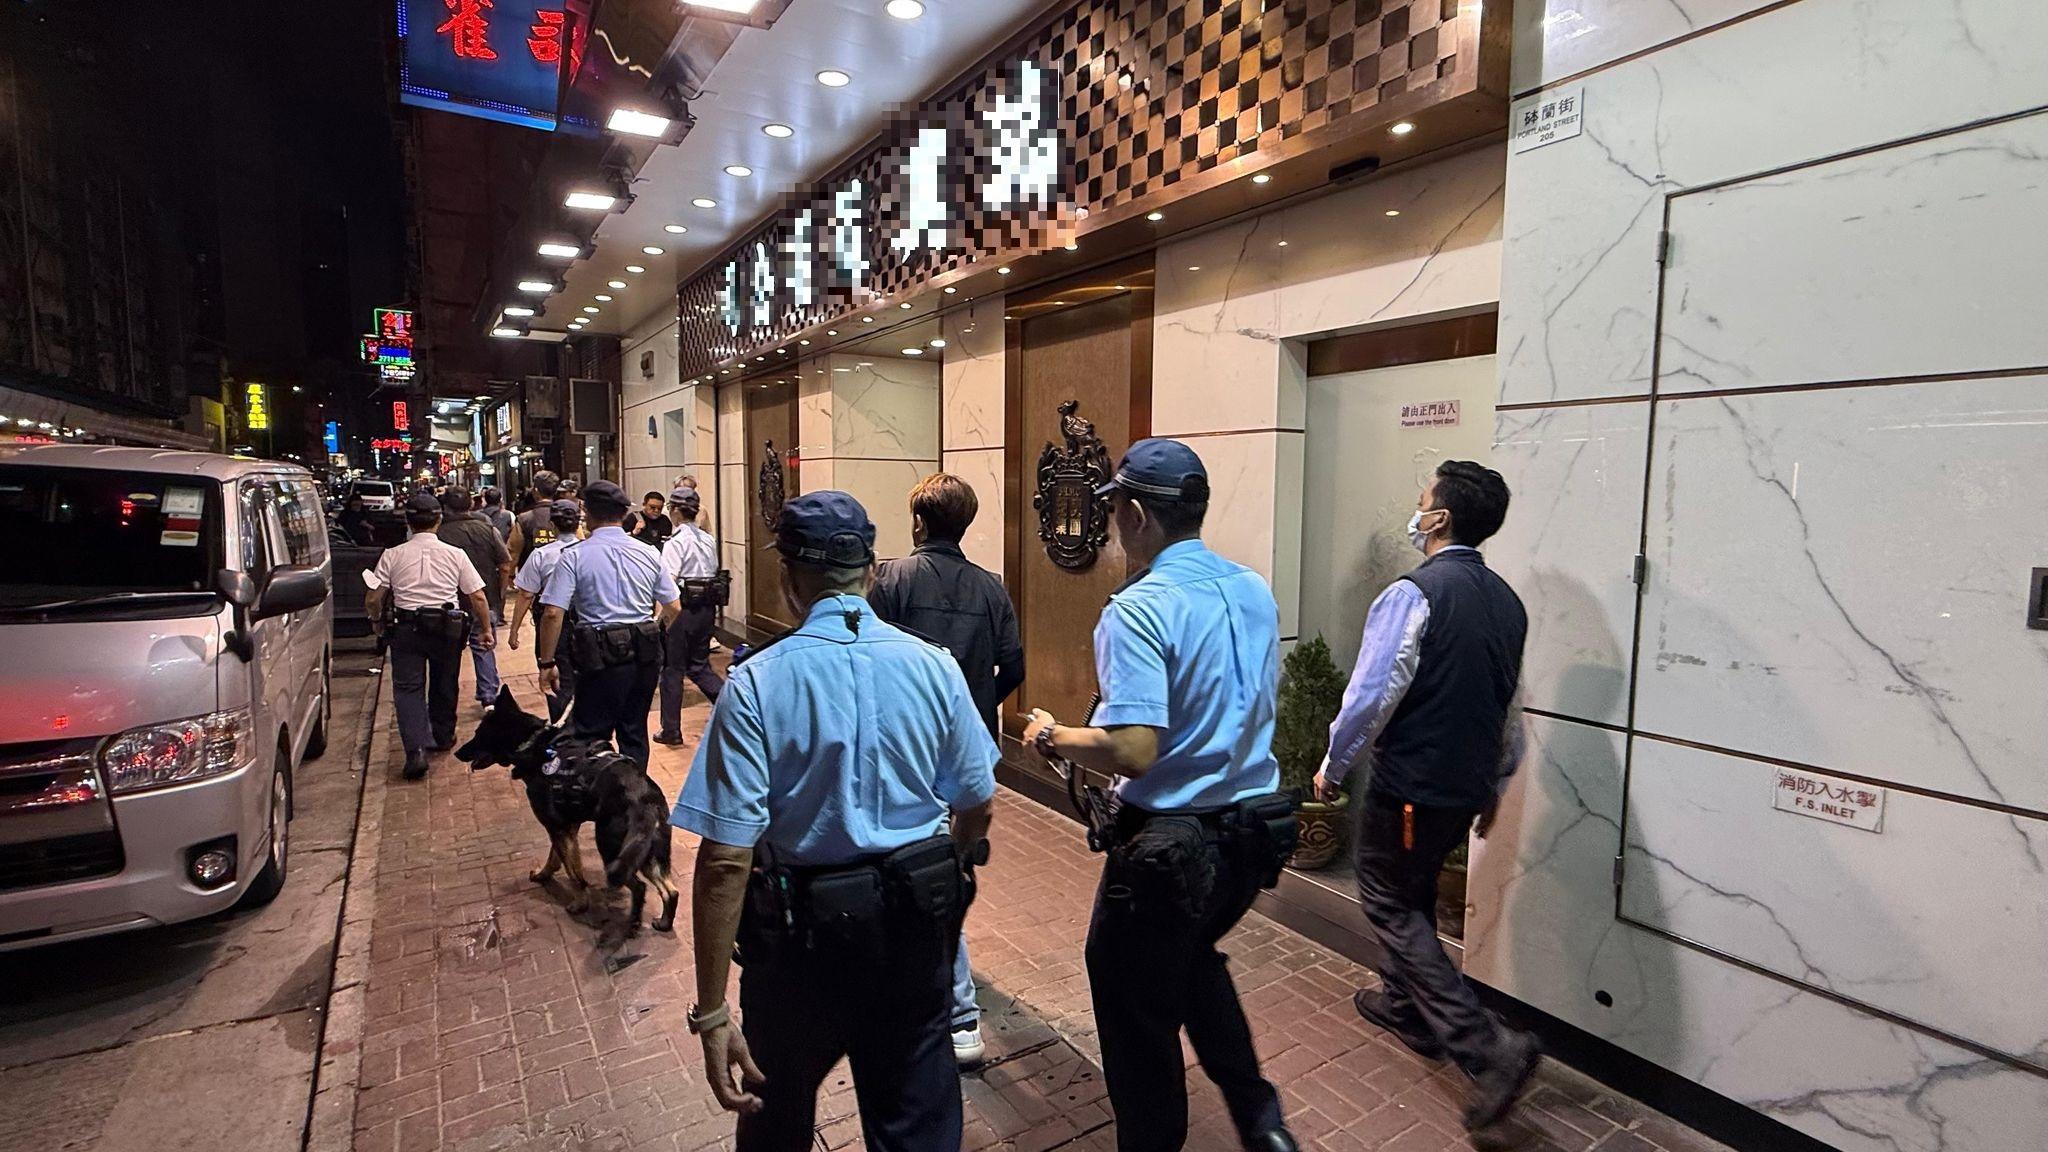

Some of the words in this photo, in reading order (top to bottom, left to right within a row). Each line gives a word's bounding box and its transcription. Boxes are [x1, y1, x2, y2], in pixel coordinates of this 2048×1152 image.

[1517, 126, 1551, 140] PORTLAND
[1553, 113, 1580, 129] STREET
[1540, 131, 1555, 142] 205
[1795, 797, 1818, 811] F.S.
[1821, 803, 1856, 819] INLET
